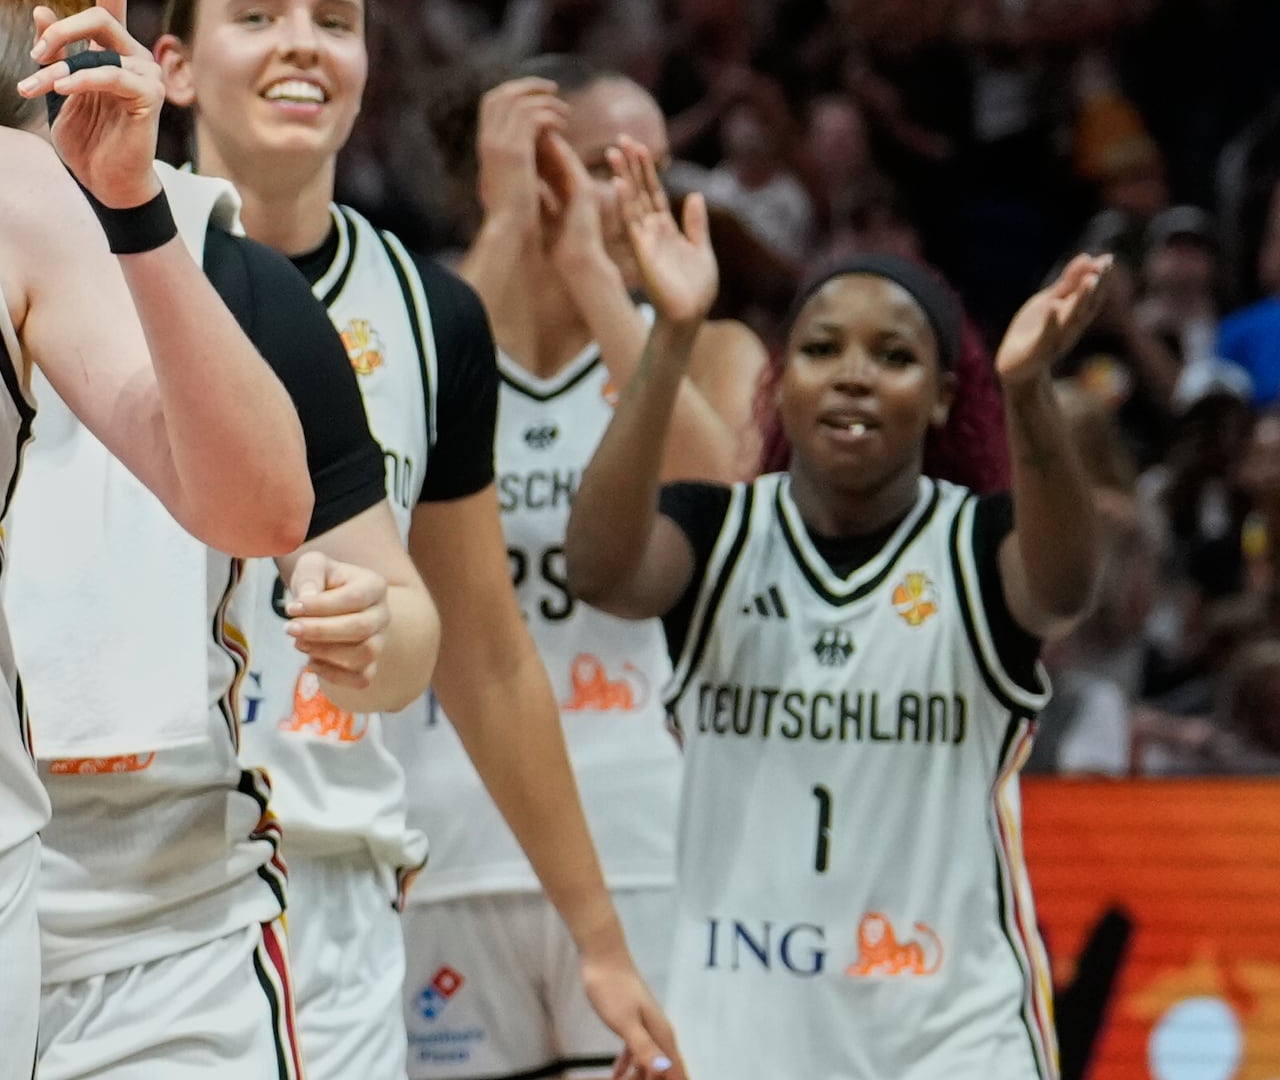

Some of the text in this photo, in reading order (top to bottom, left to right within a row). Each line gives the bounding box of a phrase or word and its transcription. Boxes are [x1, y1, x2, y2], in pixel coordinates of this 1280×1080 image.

[697, 681, 969, 747] DEUTSCHLAND
[812, 784, 833, 873] 1
[704, 918, 827, 977] ING
